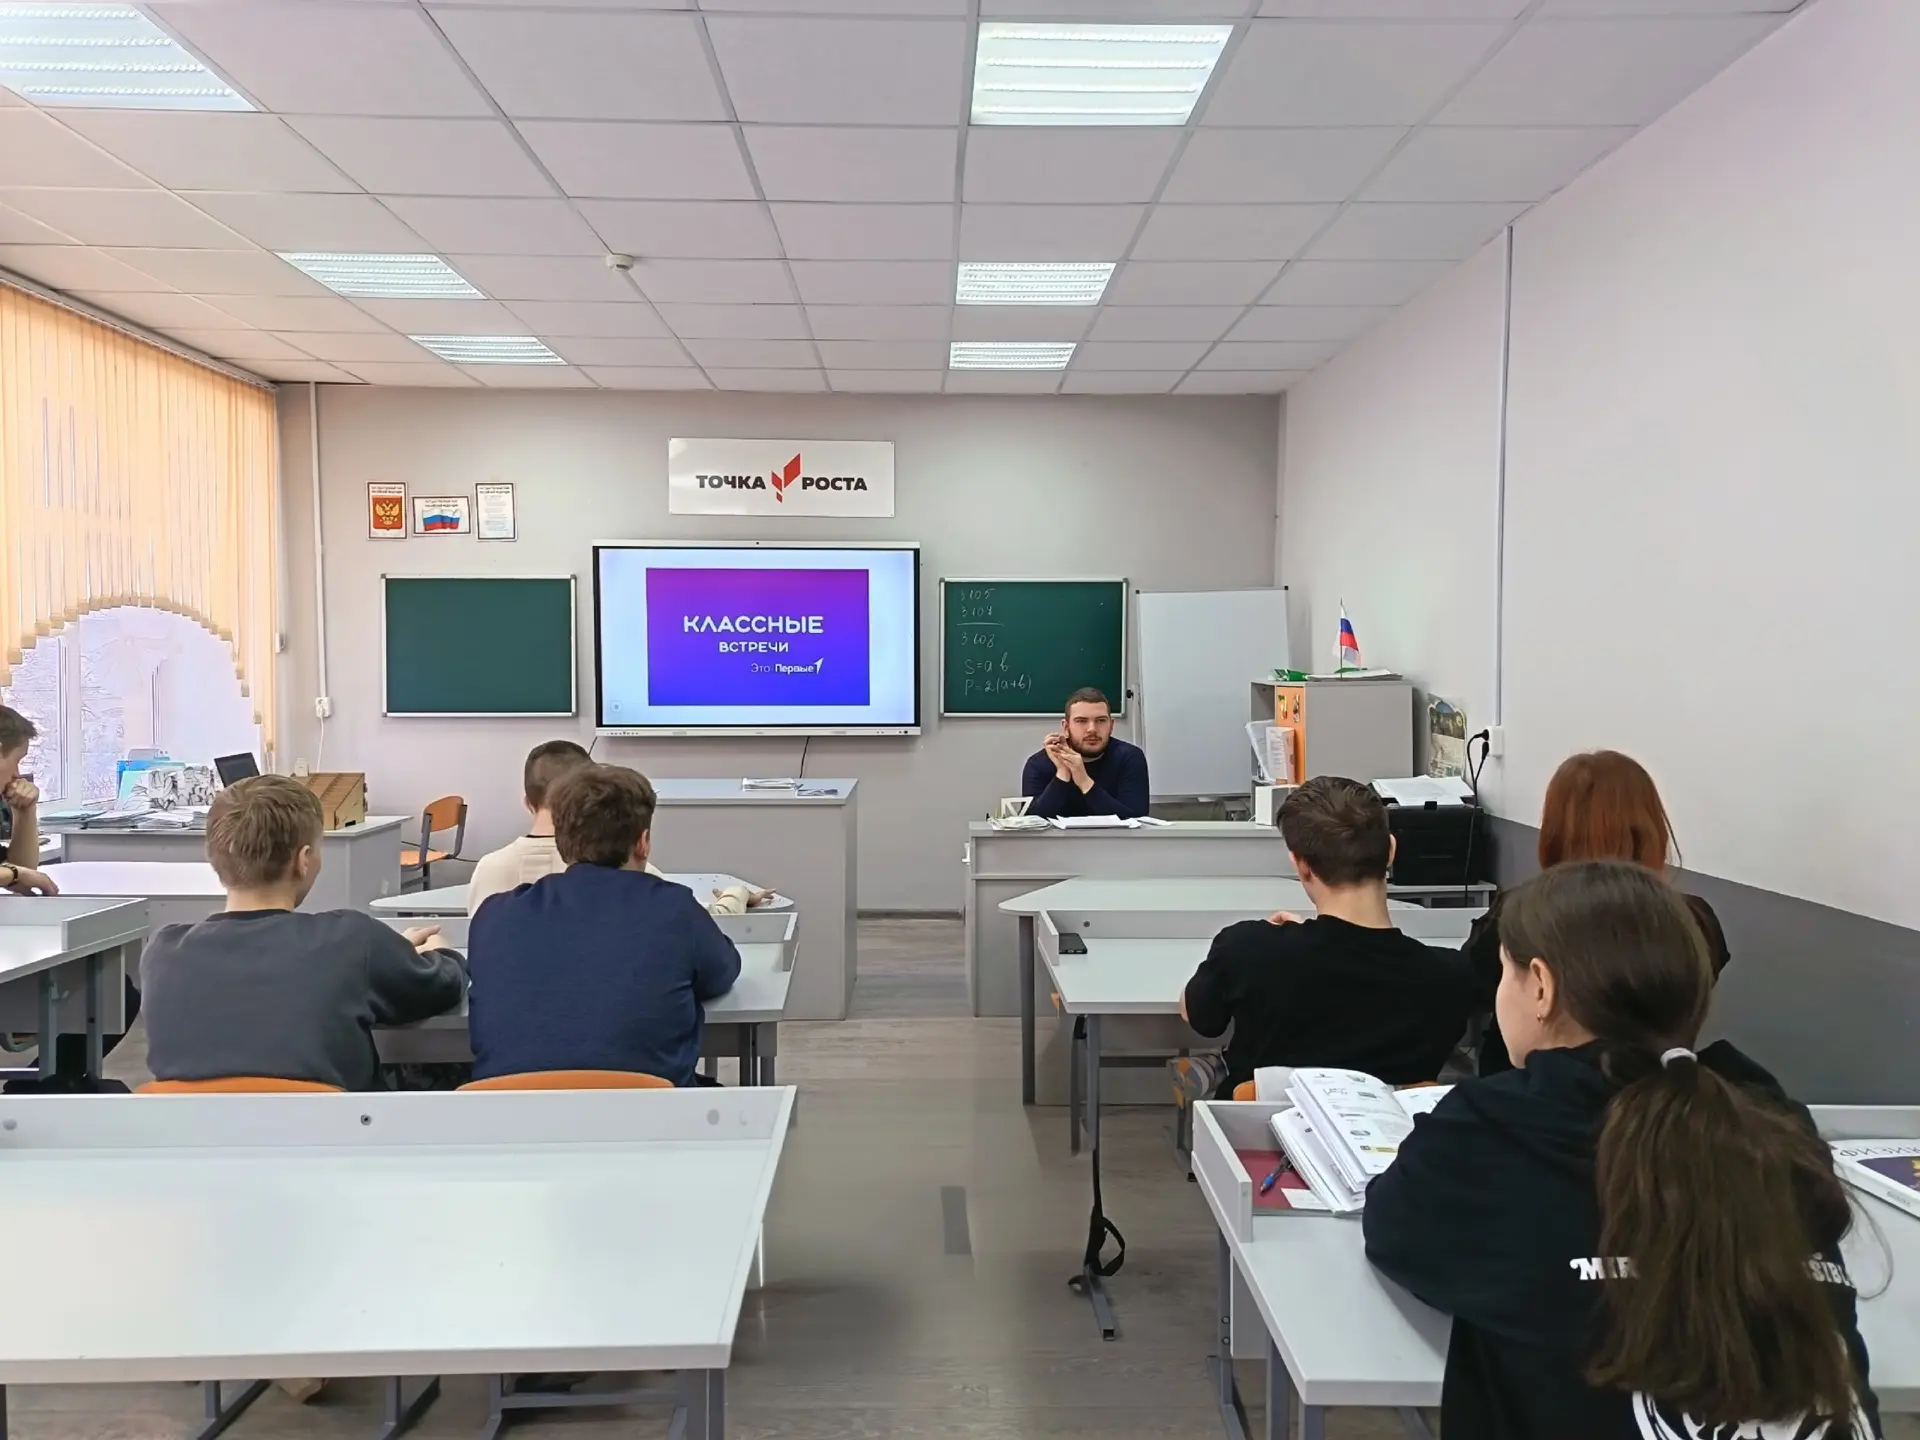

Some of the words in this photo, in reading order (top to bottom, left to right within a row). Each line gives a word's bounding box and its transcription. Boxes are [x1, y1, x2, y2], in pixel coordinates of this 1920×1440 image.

[696, 475, 766, 490] ТОЧКА
[801, 477, 868, 491] РОСТА
[683, 615, 824, 634] КЛАССНЫЕ
[719, 641, 789, 653] ВСТРЕЧИ
[751, 663, 770, 673] Это
[775, 663, 814, 675] Первые
